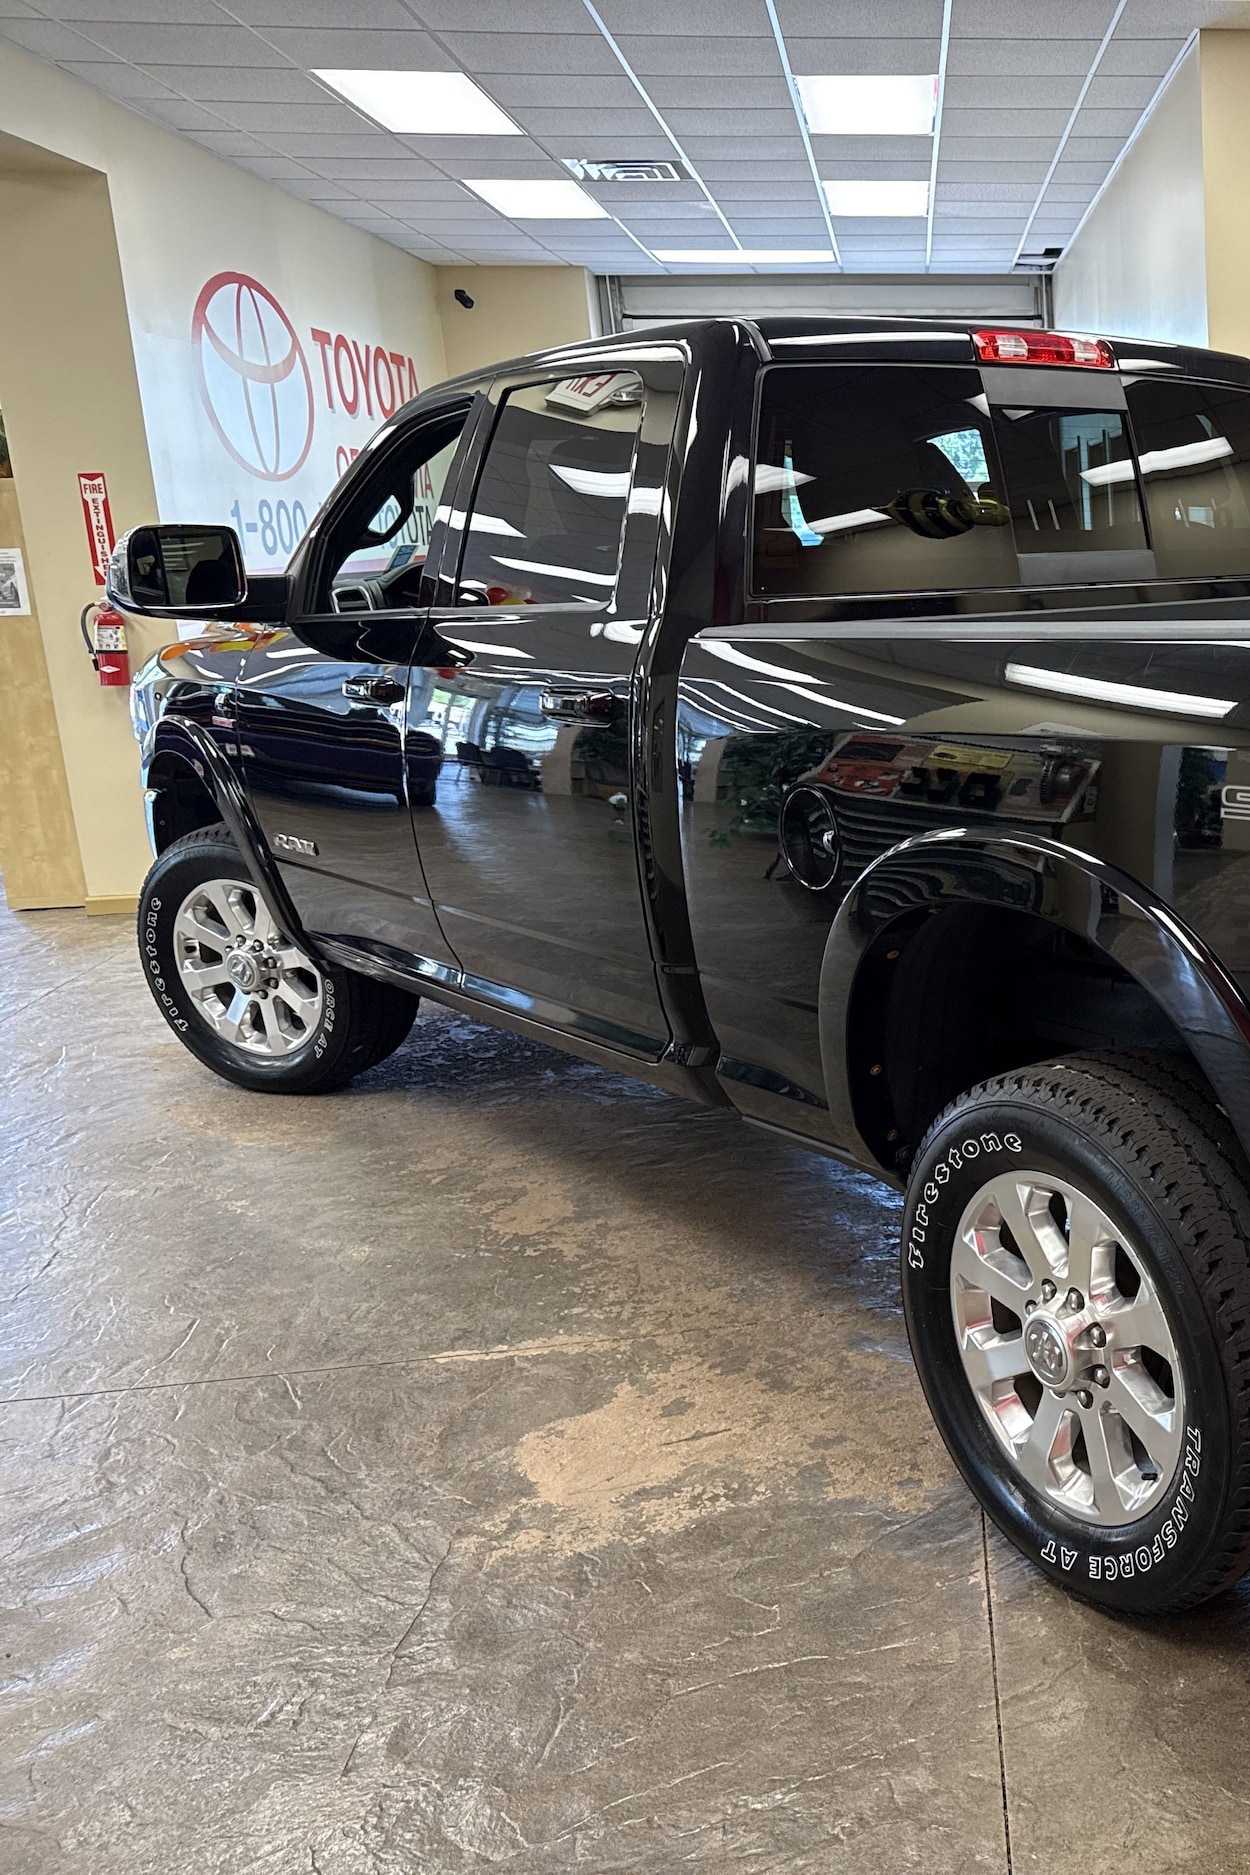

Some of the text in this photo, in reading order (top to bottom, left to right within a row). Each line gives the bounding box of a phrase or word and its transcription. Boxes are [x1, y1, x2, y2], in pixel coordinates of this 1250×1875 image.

[311, 327, 419, 420] TOYOTA
[83, 483, 104, 494] FIRE
[313, 1033, 328, 1059] AT
[907, 1131, 1023, 1269] Firestone
[1040, 1425, 1202, 1581] TRANSFORCE AT
